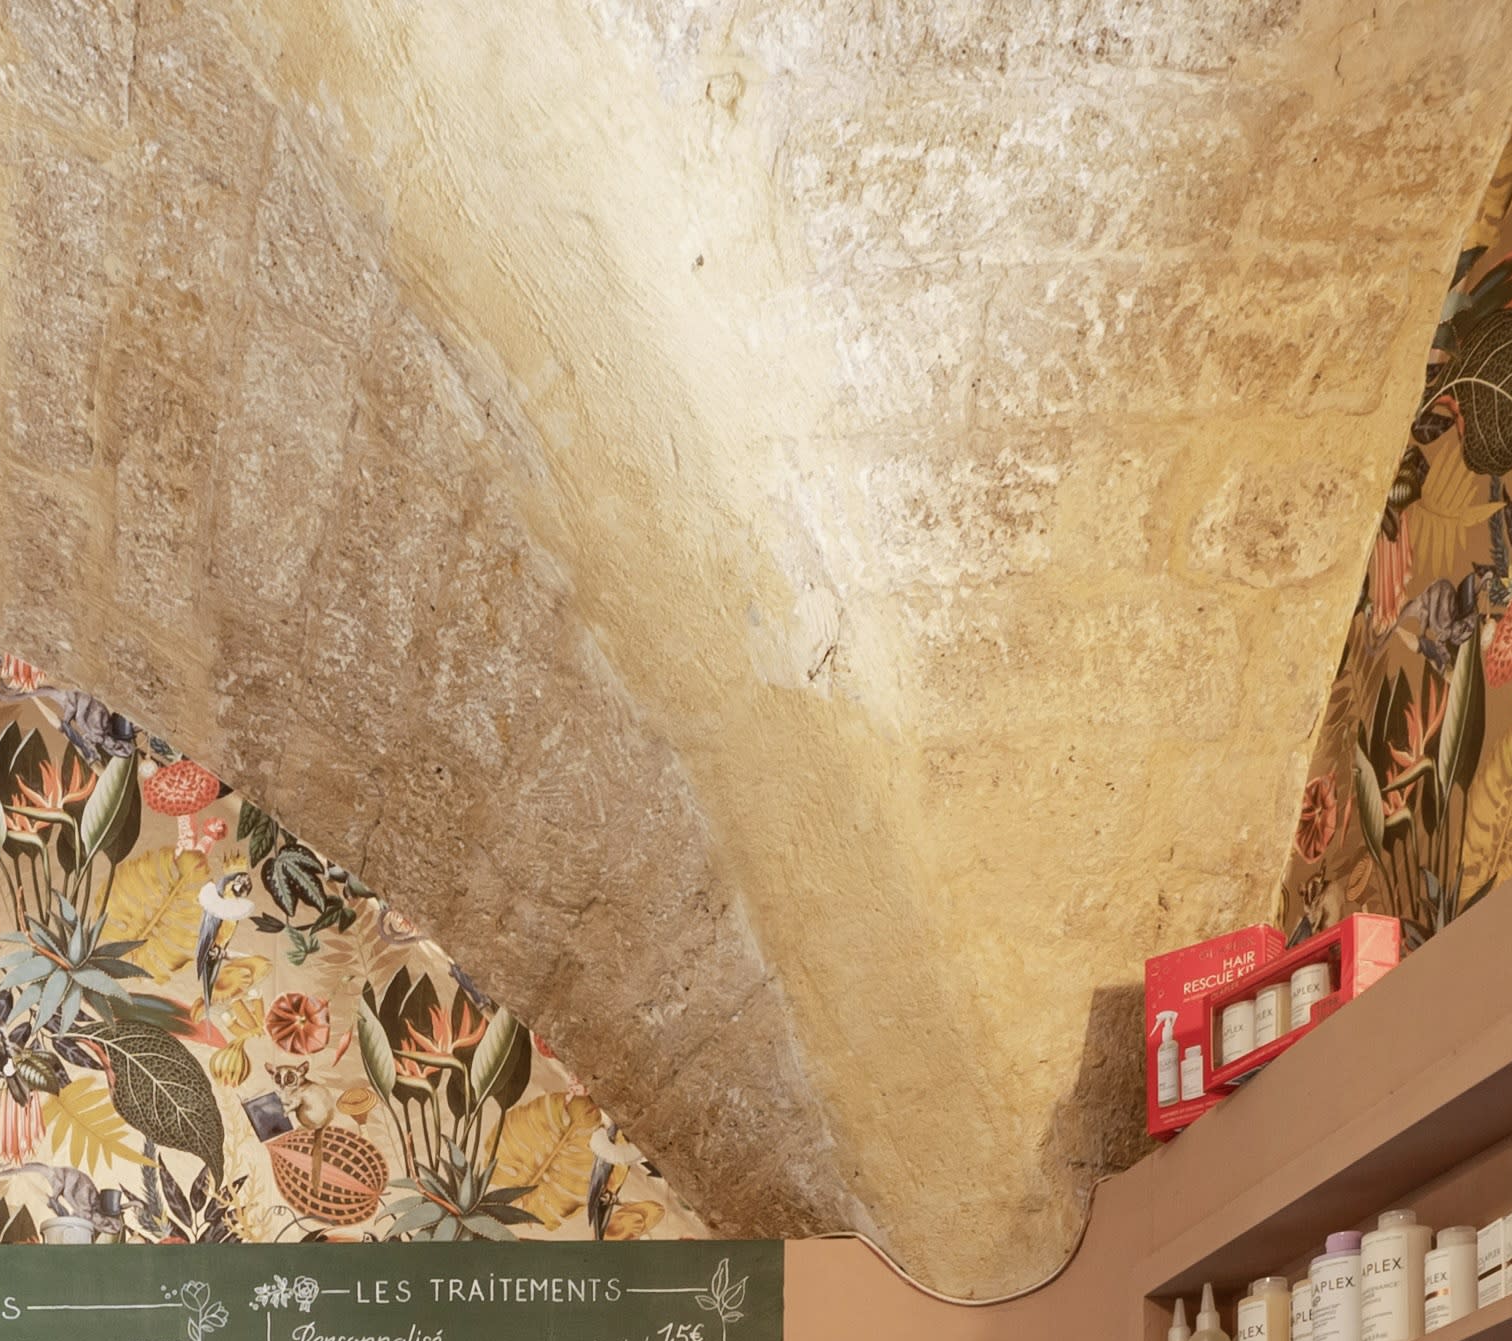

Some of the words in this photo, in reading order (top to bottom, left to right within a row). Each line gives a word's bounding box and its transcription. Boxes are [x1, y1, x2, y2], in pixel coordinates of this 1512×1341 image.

[1222, 950, 1256, 971] HAIR
[1183, 971, 1234, 995] RESCUE
[1237, 963, 1256, 978] KIT
[356, 1279, 412, 1304] LES
